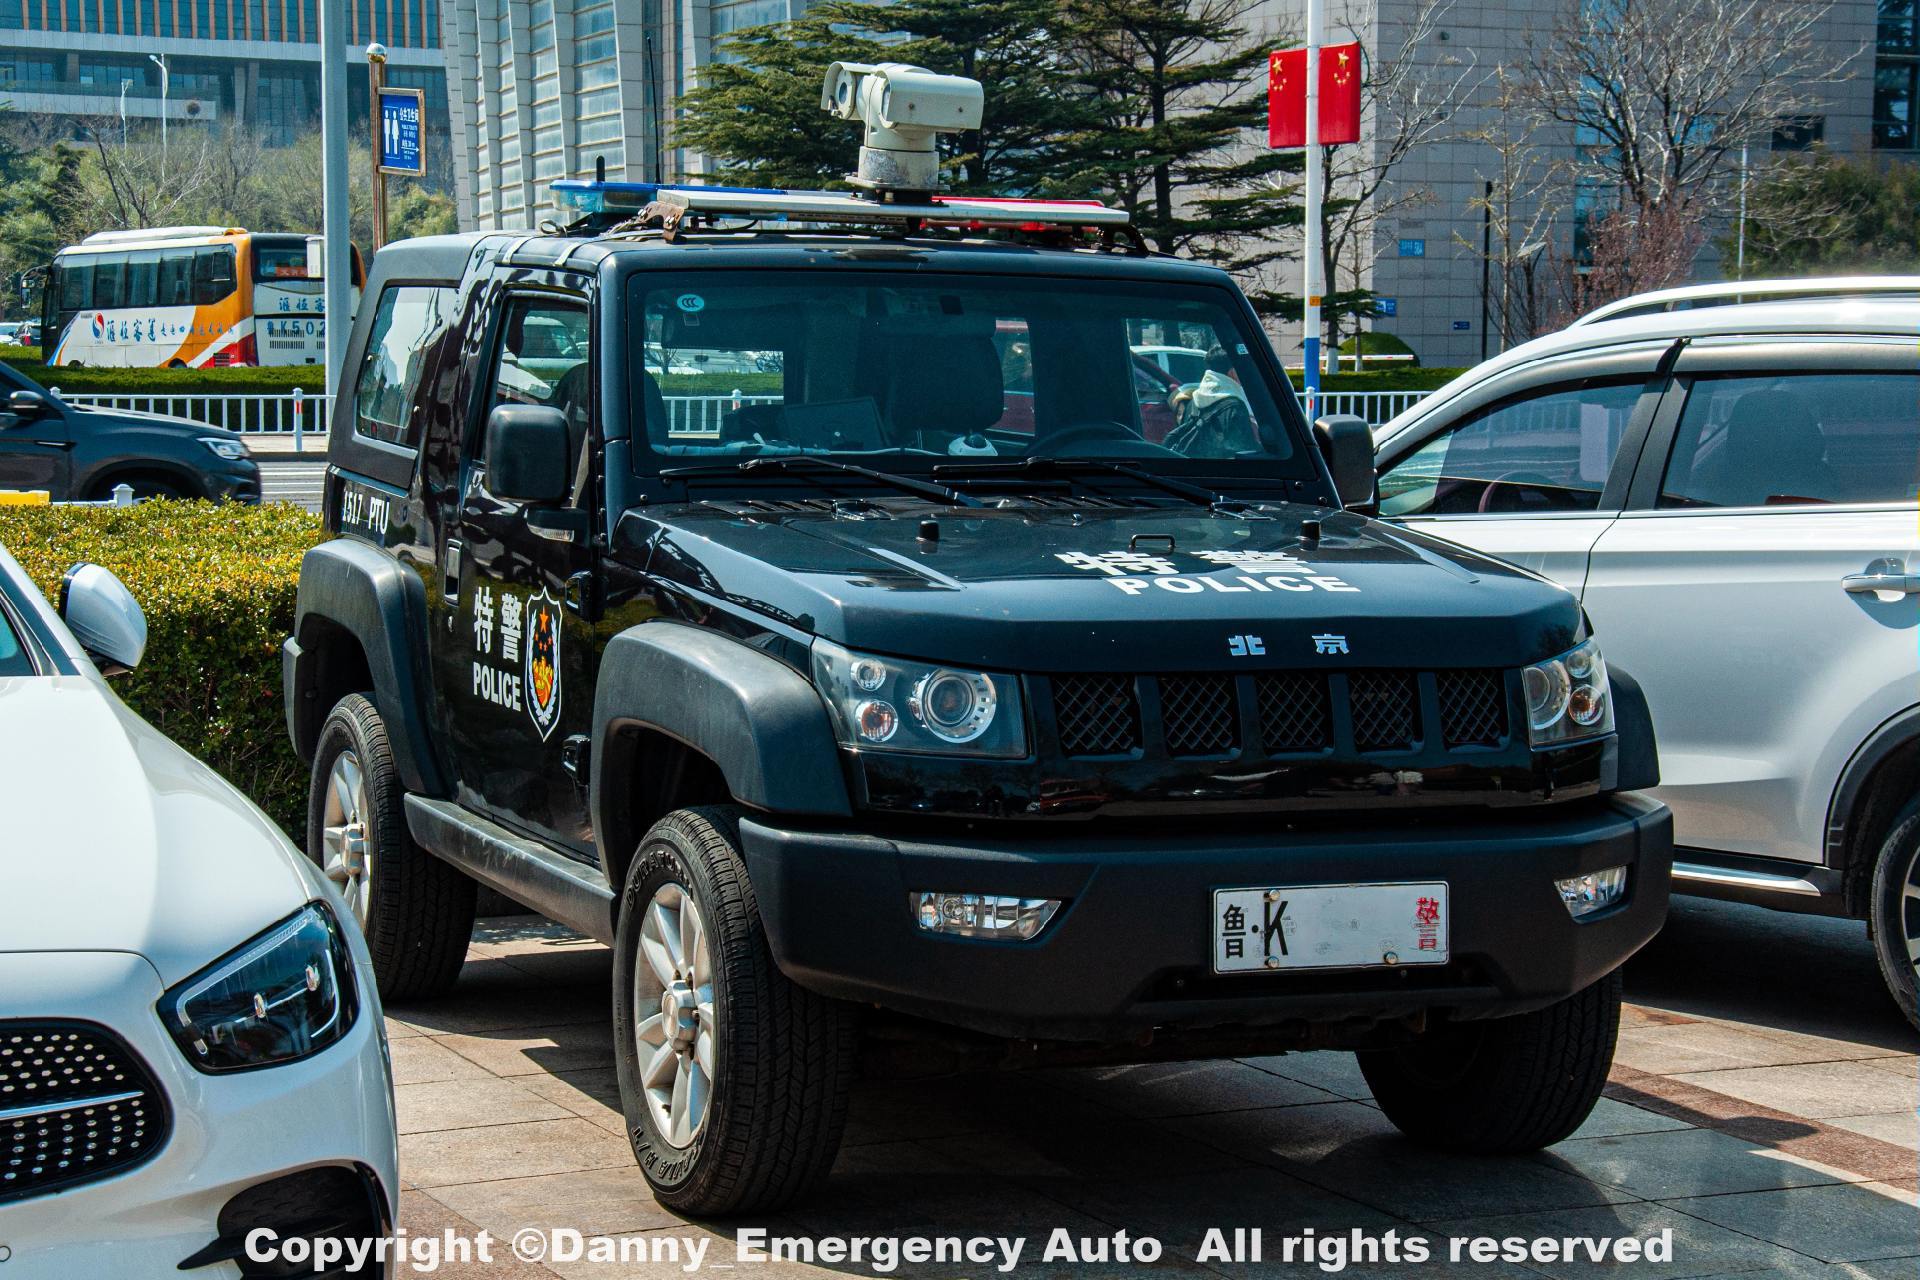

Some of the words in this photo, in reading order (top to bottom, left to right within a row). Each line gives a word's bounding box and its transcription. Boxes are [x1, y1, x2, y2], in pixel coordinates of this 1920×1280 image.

[342, 491, 363, 525] 1517
[368, 497, 390, 535] PTU
[1054, 550, 1317, 575] 特警
[1102, 576, 1361, 595] POLICE
[473, 586, 522, 663] 特警
[1228, 633, 1351, 657] 北京
[473, 661, 522, 712] POLICE
